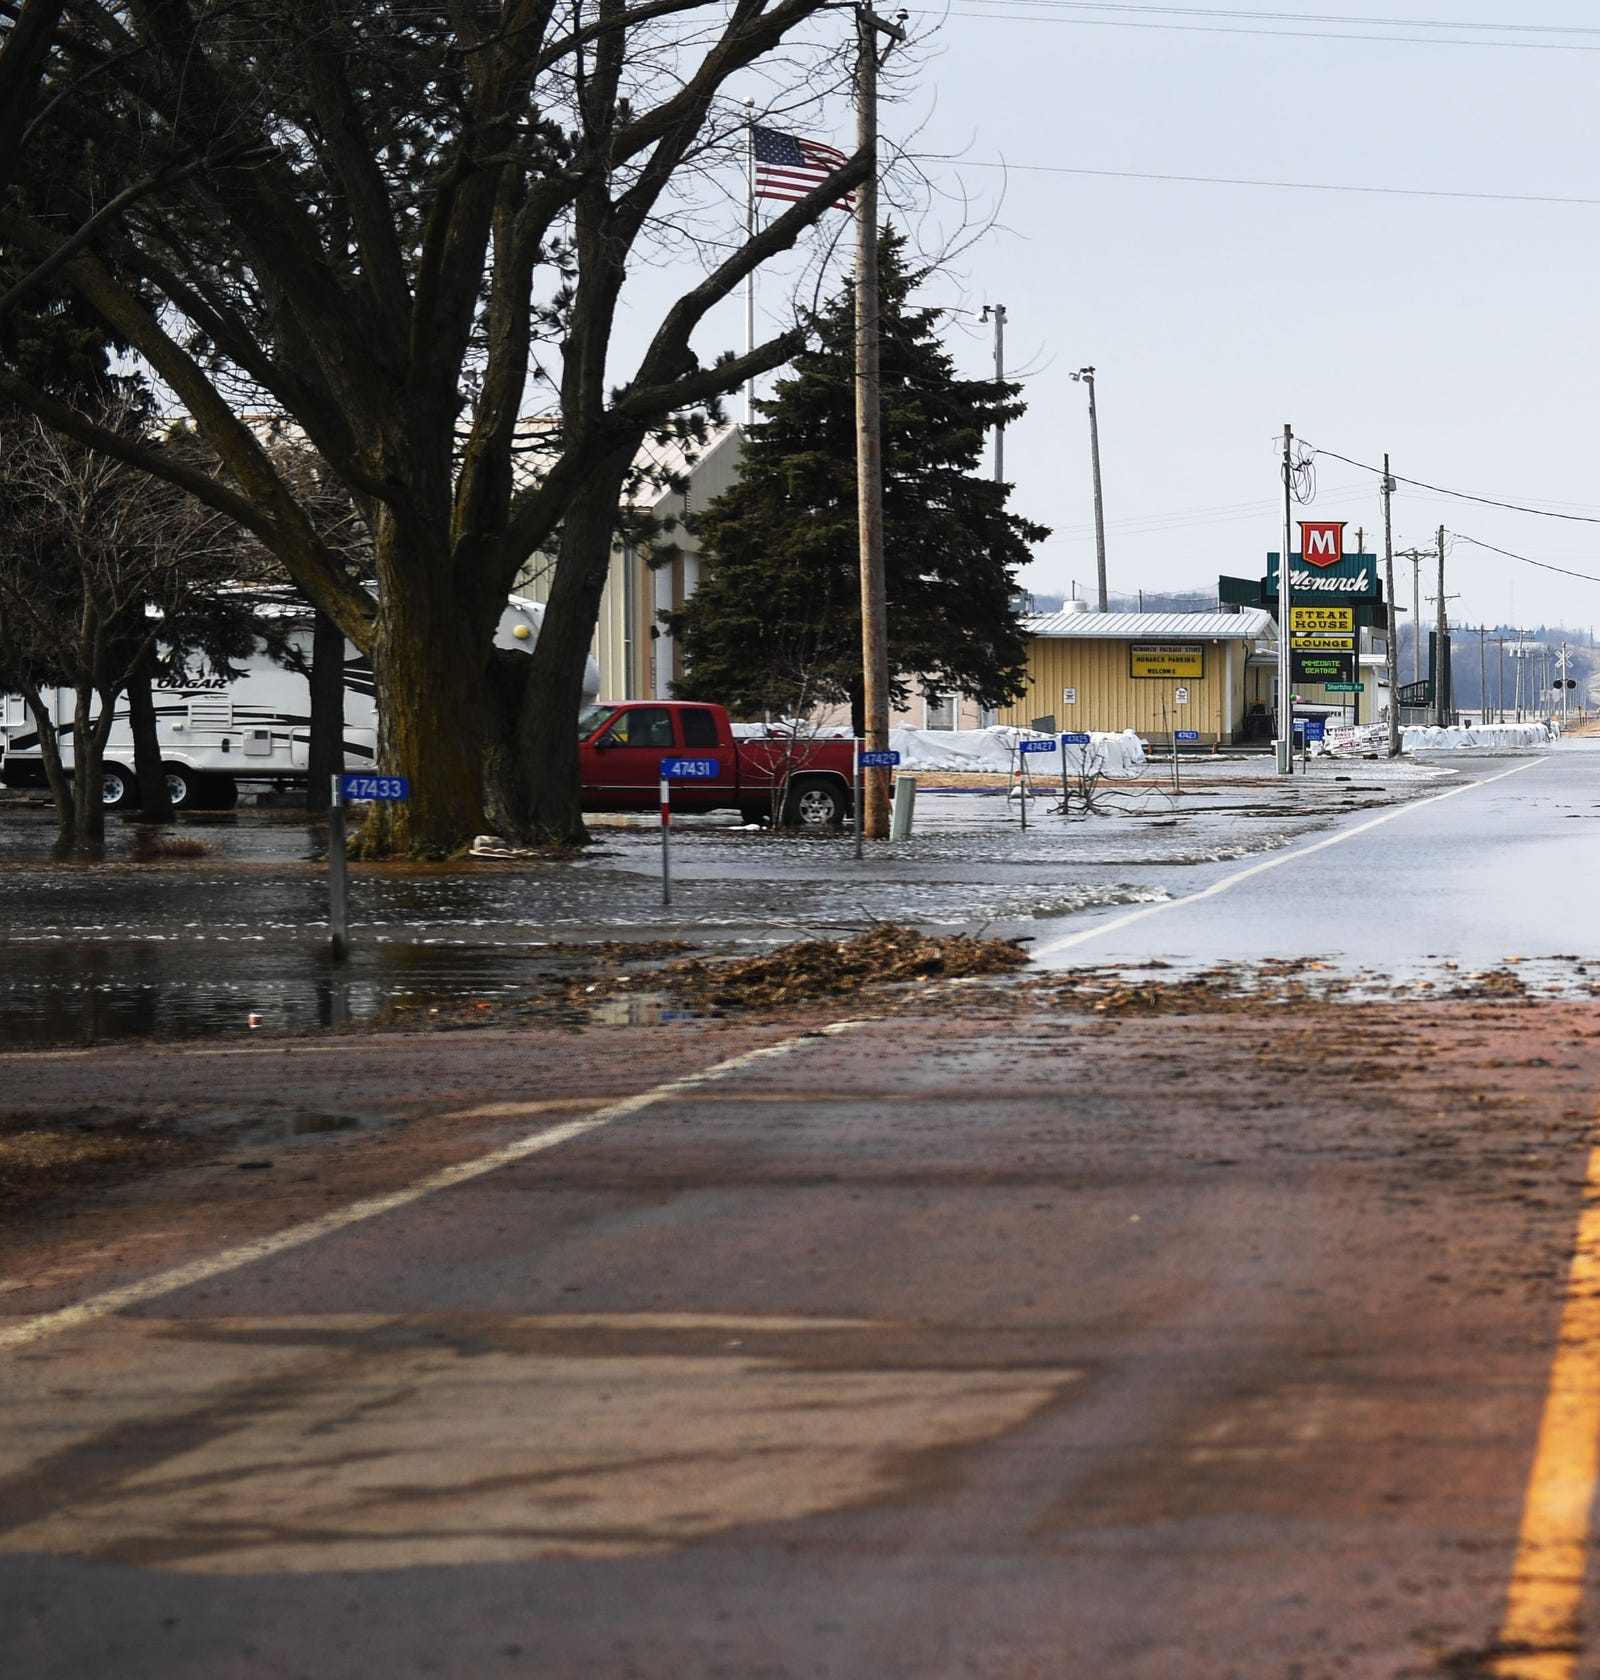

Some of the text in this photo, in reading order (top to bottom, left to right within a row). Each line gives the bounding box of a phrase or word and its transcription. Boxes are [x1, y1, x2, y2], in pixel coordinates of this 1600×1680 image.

[1307, 530, 1337, 555] M
[1272, 568, 1370, 592] Monarch
[1295, 611, 1348, 619] STEAK
[1295, 620, 1348, 629] HOUSE
[156, 679, 228, 690] OUGAR
[1026, 741, 1053, 752] 47427
[862, 753, 897, 765] 47429
[671, 761, 710, 776] 47431
[346, 779, 402, 797] 47433
